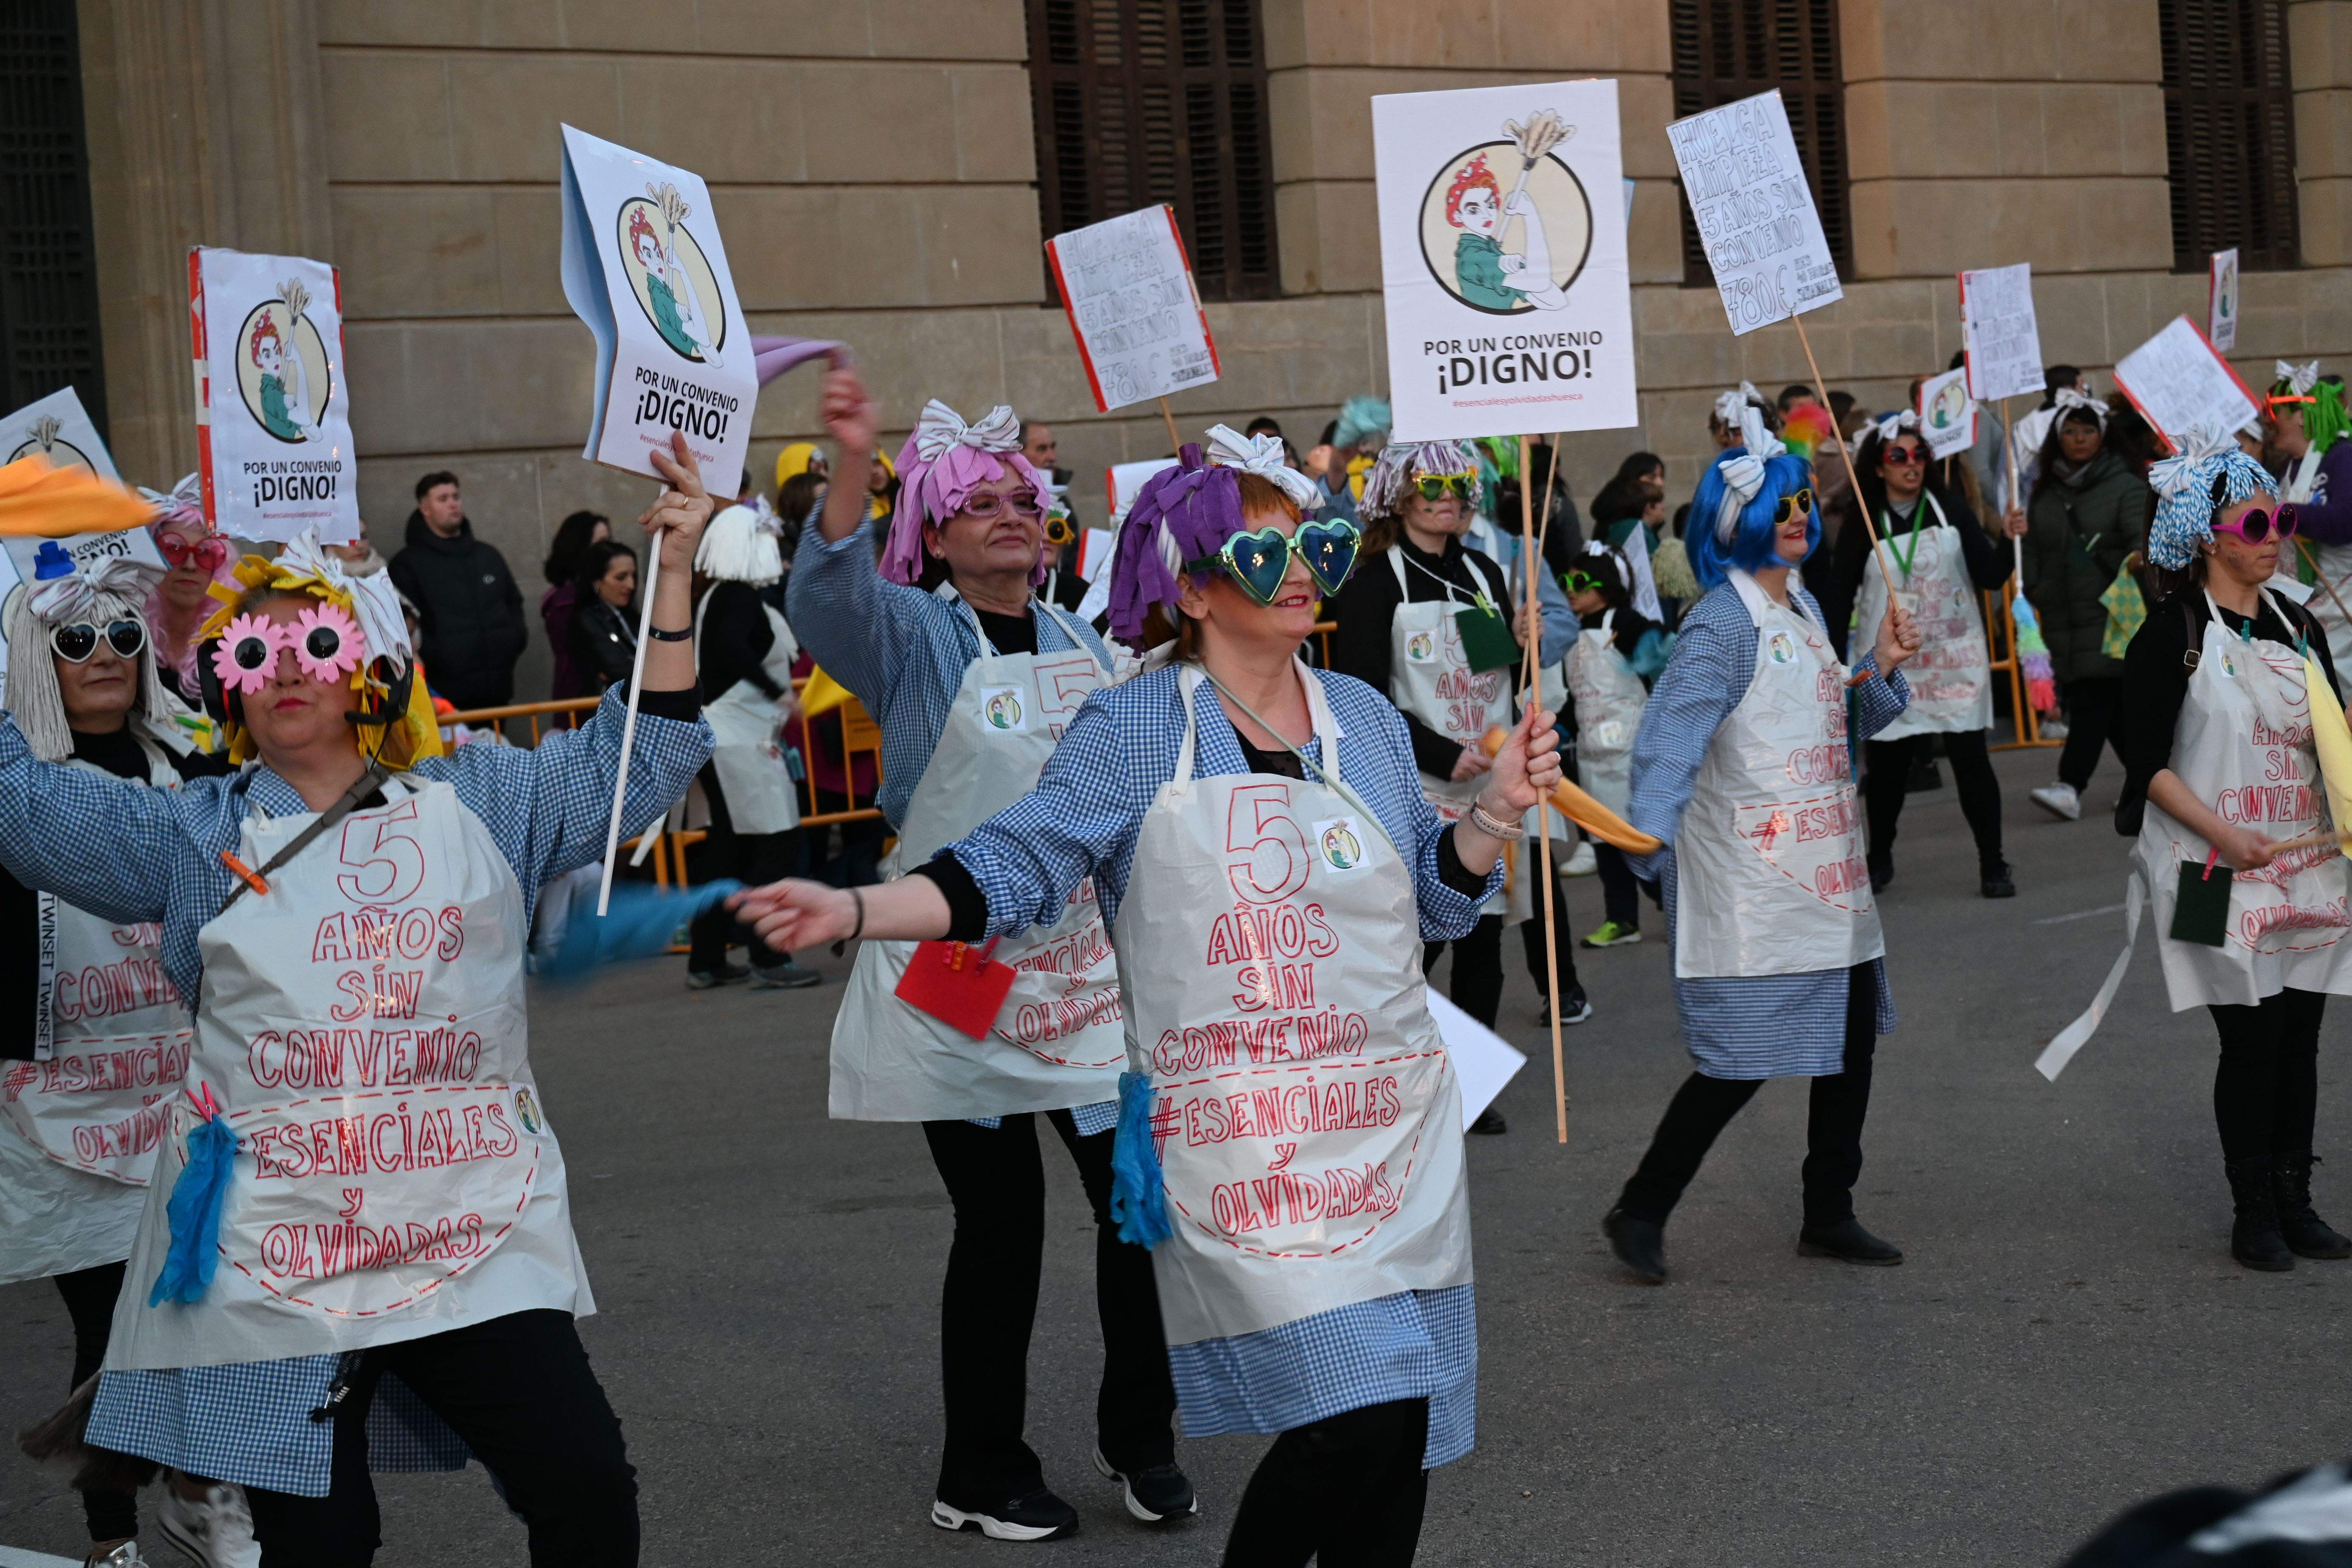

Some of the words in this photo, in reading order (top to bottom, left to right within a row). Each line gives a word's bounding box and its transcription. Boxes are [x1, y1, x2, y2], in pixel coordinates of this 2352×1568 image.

[1672, 99, 1775, 164] HUELGA
[1684, 143, 1783, 205] LIMPIEZA
[1699, 206, 1720, 239] 5
[1723, 188, 1772, 232] AÑOS
[1773, 175, 1806, 210] SIN
[1711, 214, 1804, 272] CONVENIO
[1424, 340, 1462, 356] POR
[1468, 338, 1497, 353] UN
[1502, 330, 1603, 351] CONVENIO
[1438, 349, 1592, 394] ¡DIGNO!
[635, 366, 659, 388] POR
[662, 375, 679, 394] UN
[681, 381, 738, 413] CONVENIO
[635, 389, 729, 444] ¡DIGNO!
[243, 462, 268, 474] POR
[271, 461, 287, 474] UN
[290, 460, 342, 473] CONVENIO
[254, 475, 335, 507] ¡DIGNO!
[1435, 669, 1497, 702] AÑOS
[1446, 701, 1484, 732] SIN
[337, 799, 425, 905] 5
[1226, 783, 1310, 905] 5
[41, 894, 55, 970] TWINSET
[312, 905, 464, 963] AÑOS
[1207, 902, 1339, 966] AÑOS
[38, 980, 52, 1052] TWINSET
[331, 963, 423, 1021] SIN
[1233, 960, 1316, 1012] SIN
[248, 1015, 481, 1089] CONVENIO
[1153, 1004, 1368, 1077] CONVENIO
[235, 1102, 518, 1179] ESENCIALES
[1148, 1075, 1401, 1166] #ESENCIALES
[1211, 1162, 1397, 1236] OLVIDADAS
[261, 1213, 483, 1279] OLVIDADAS
